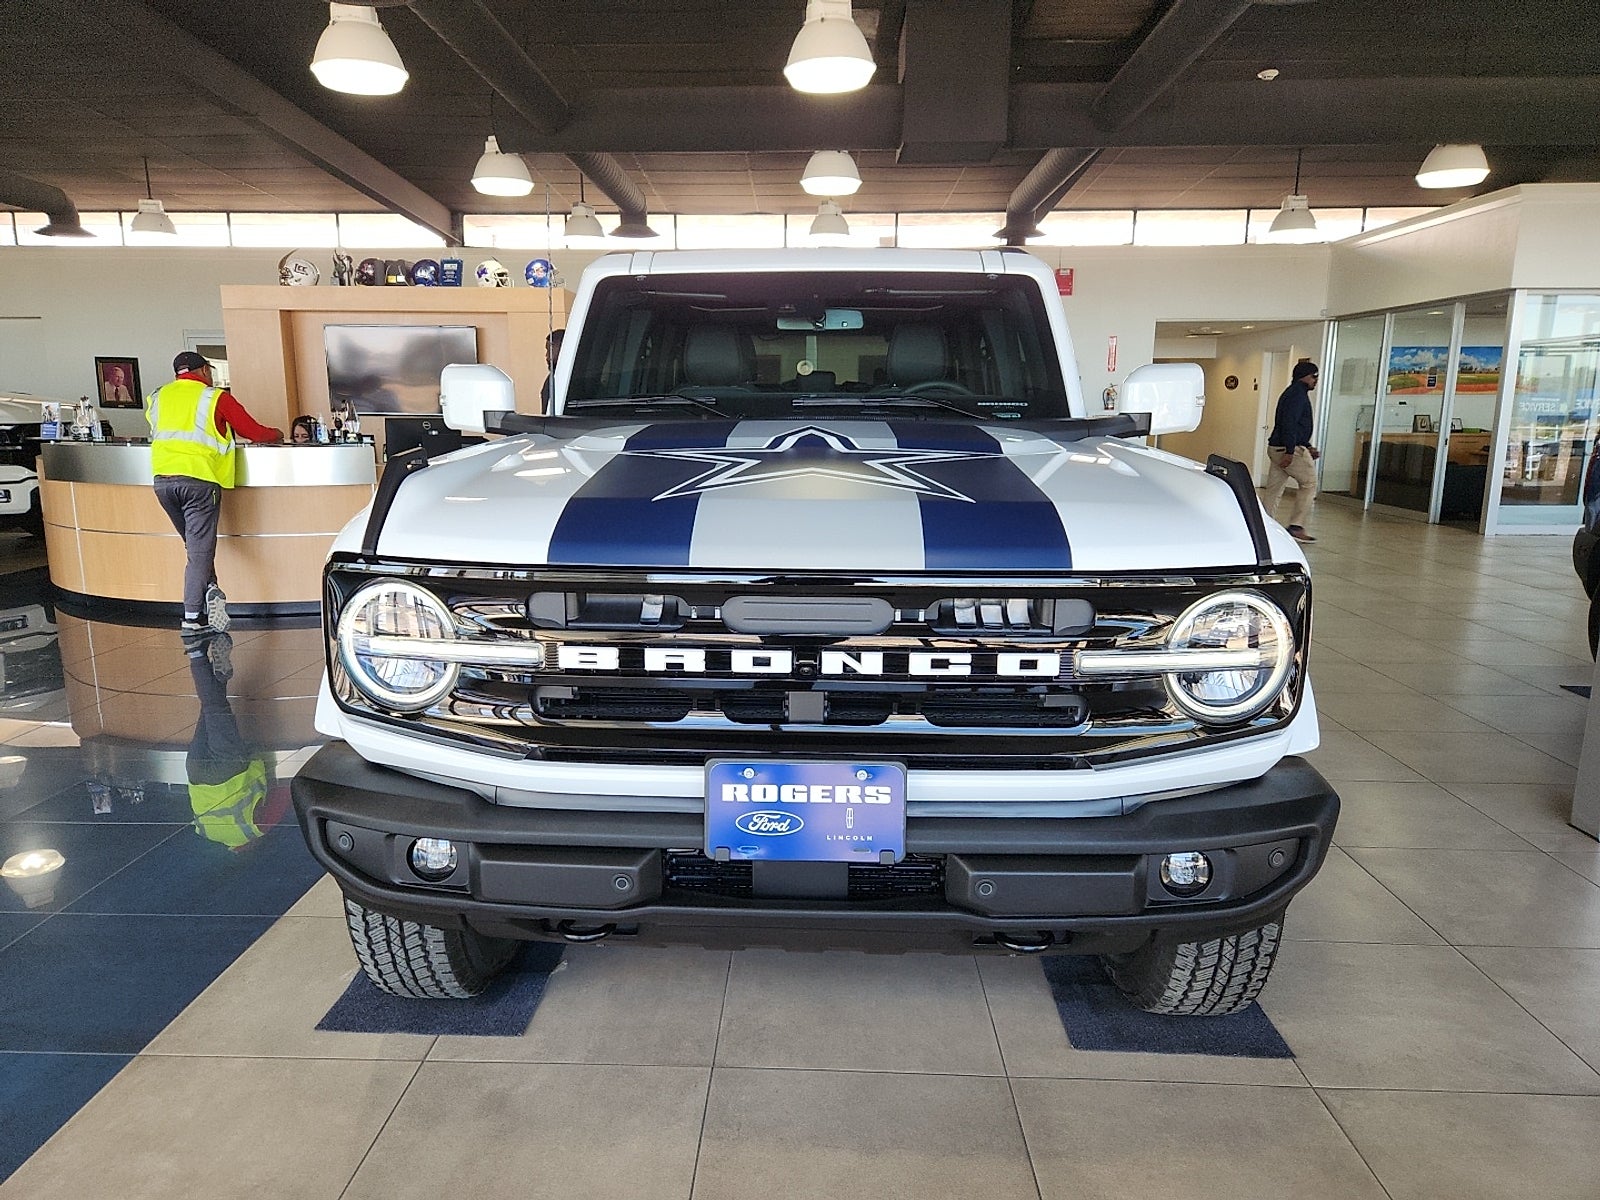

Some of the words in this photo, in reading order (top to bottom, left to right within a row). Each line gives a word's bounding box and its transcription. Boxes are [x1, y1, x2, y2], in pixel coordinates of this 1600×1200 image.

[558, 646, 1059, 677] BRONCO
[721, 783, 892, 805] ROGERS
[747, 813, 792, 833] Ford
[826, 834, 874, 842] LINCOLN
